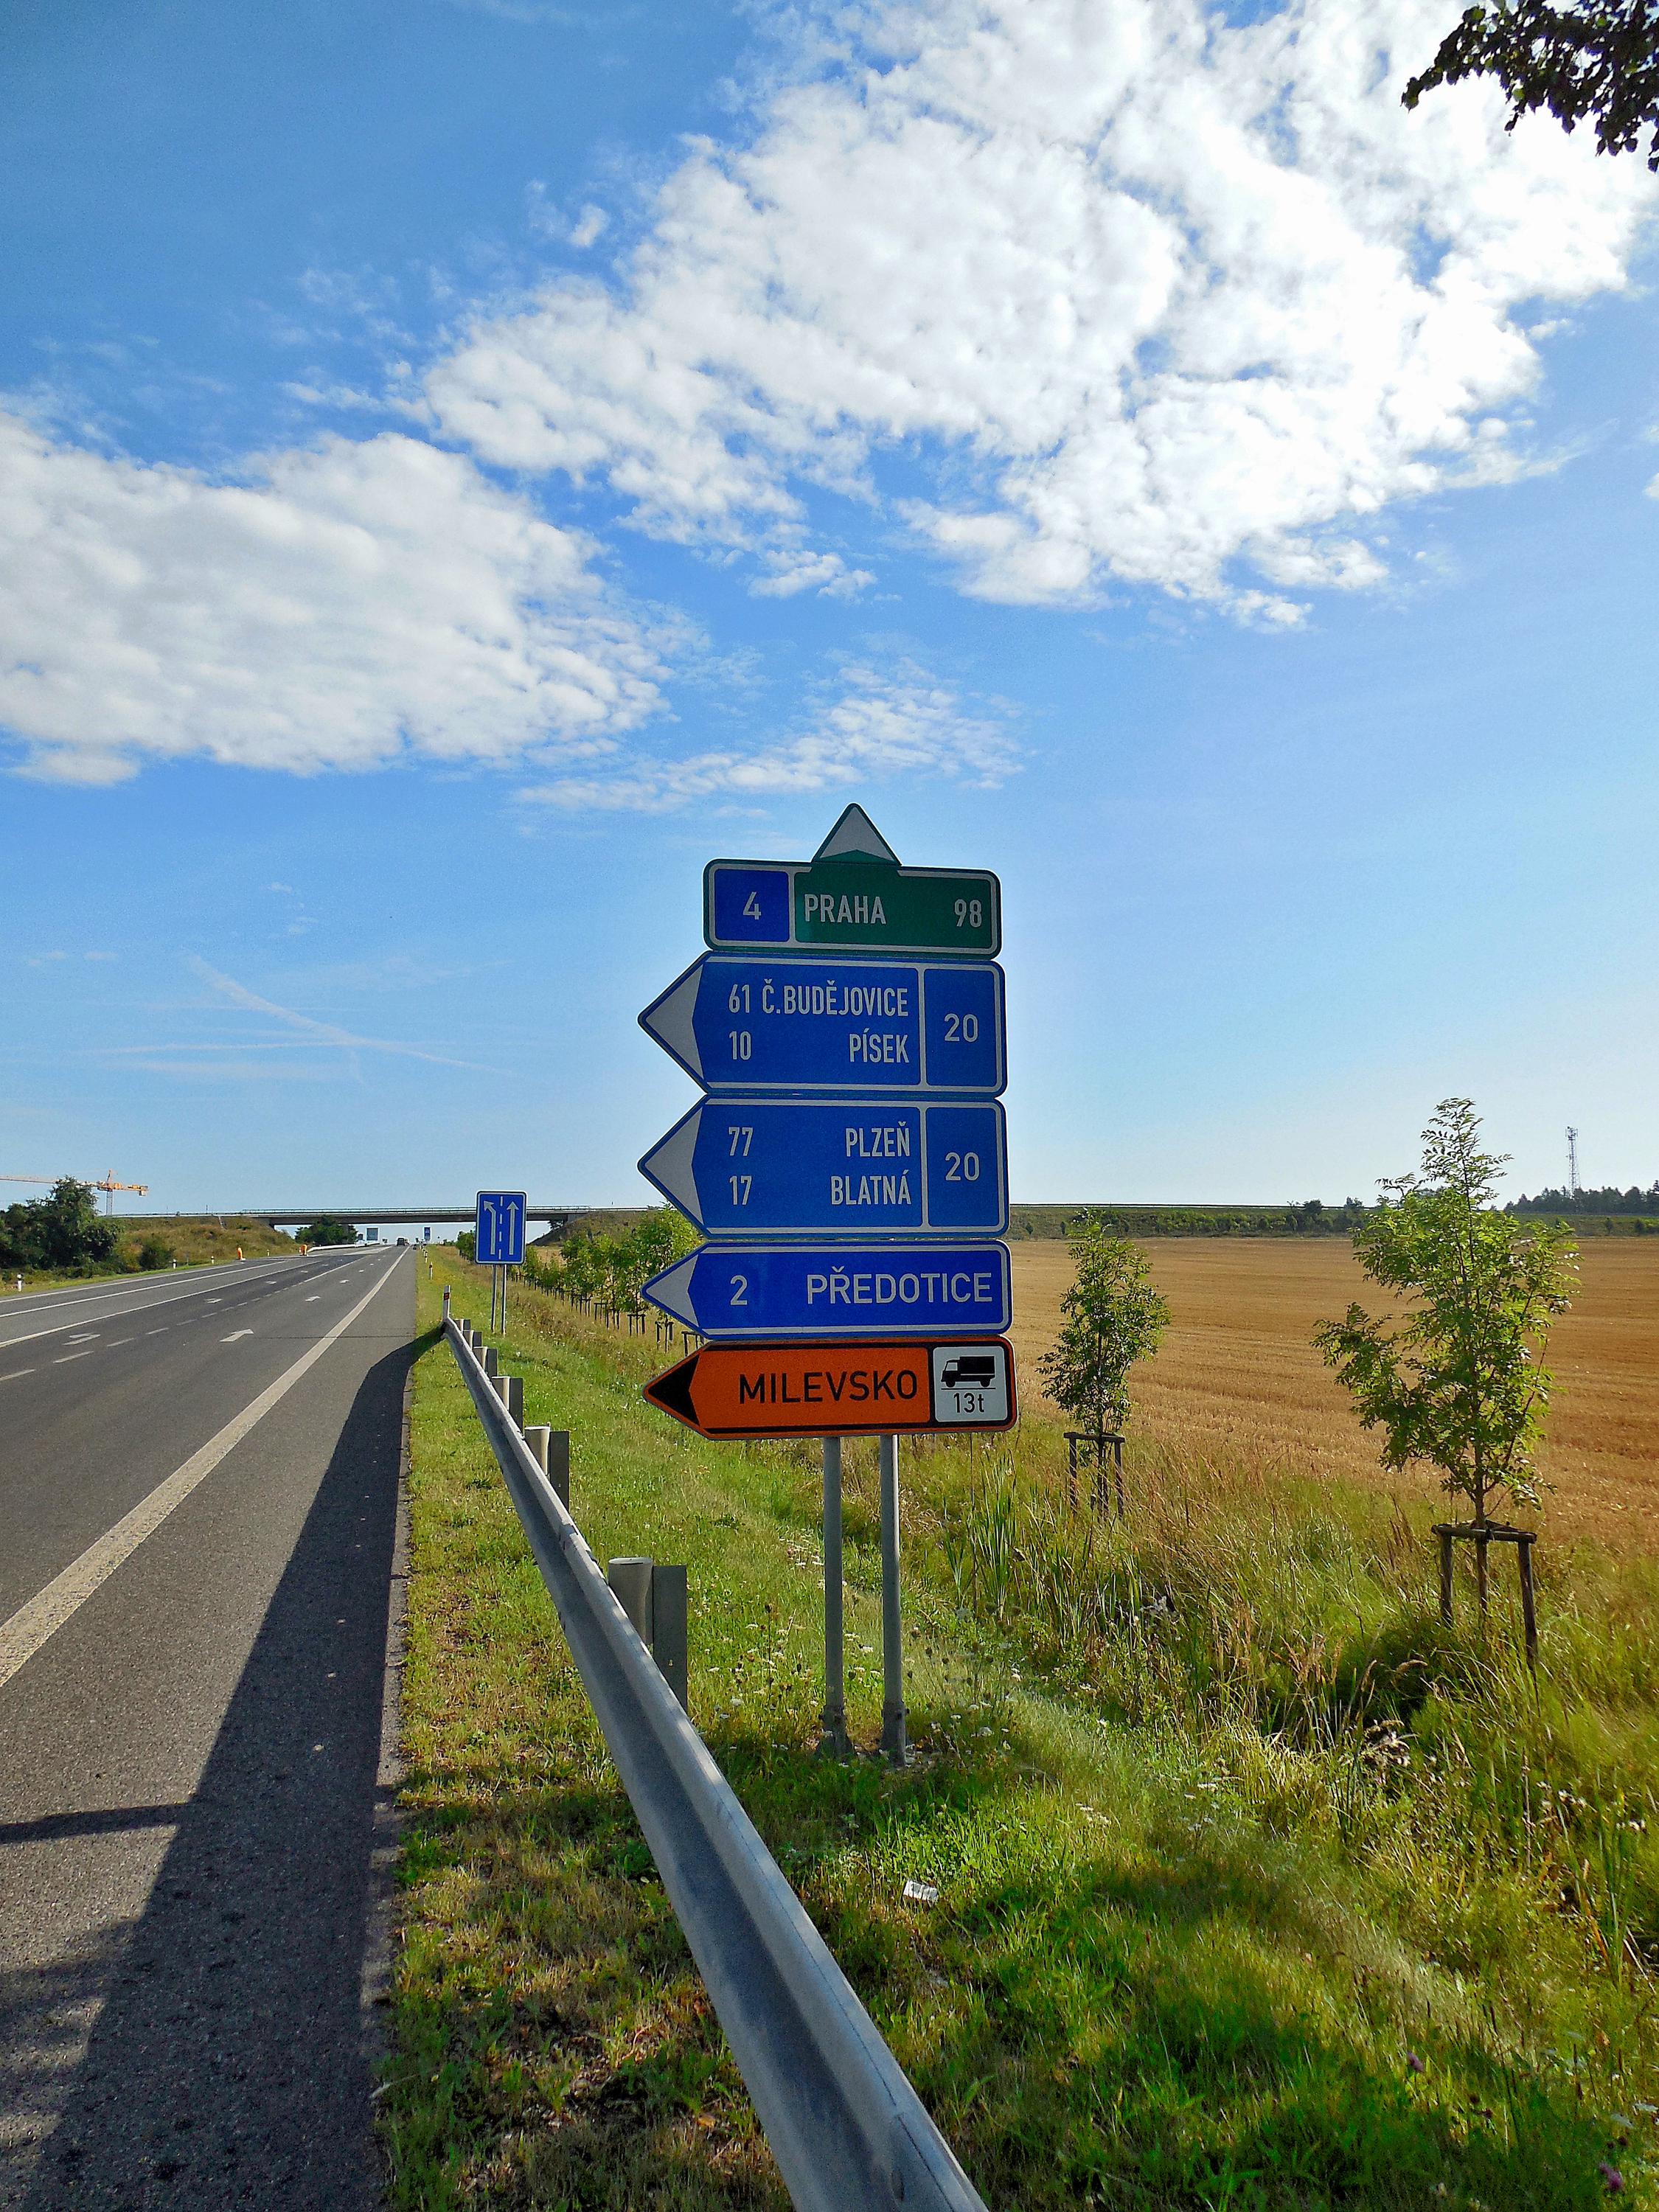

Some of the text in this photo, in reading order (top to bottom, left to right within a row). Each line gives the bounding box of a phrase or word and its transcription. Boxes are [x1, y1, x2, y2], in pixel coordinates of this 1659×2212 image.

[742, 891, 762, 920] 4
[804, 894, 887, 925] PRAHA
[953, 899, 982, 929] 98
[728, 978, 908, 1017] 61 Č.BUDĚJOVICE
[944, 1013, 978, 1043] 20
[728, 1028, 909, 1063] 10 PÍSEK
[728, 1121, 911, 1158] 77 PLZEŇ
[945, 1152, 980, 1181] 20
[728, 1169, 911, 1206] 17 BLATNÁ
[729, 1266, 993, 1306] 2 PŘEDOTICE
[738, 1369, 918, 1405] MILEVSKO
[953, 1392, 985, 1414] 13t
